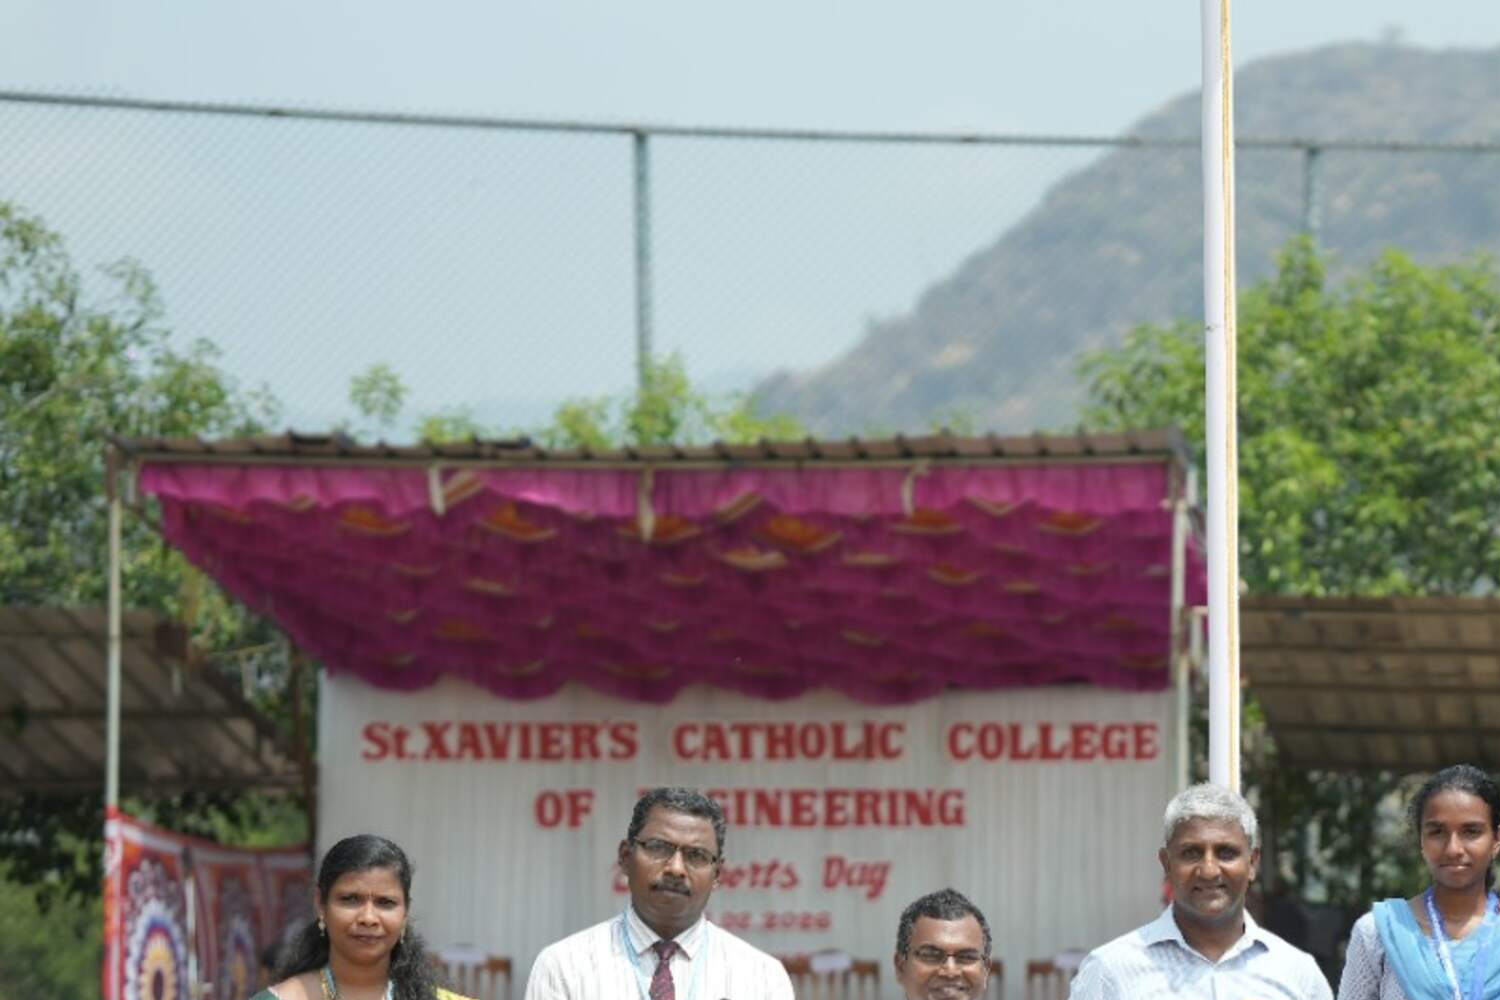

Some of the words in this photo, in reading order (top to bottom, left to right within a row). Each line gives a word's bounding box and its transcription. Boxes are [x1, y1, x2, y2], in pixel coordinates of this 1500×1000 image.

[672, 720, 905, 761] CATHOLIC
[946, 721, 1159, 761] COLLEGE
[533, 788, 597, 829] OF
[822, 855, 891, 899] Day
